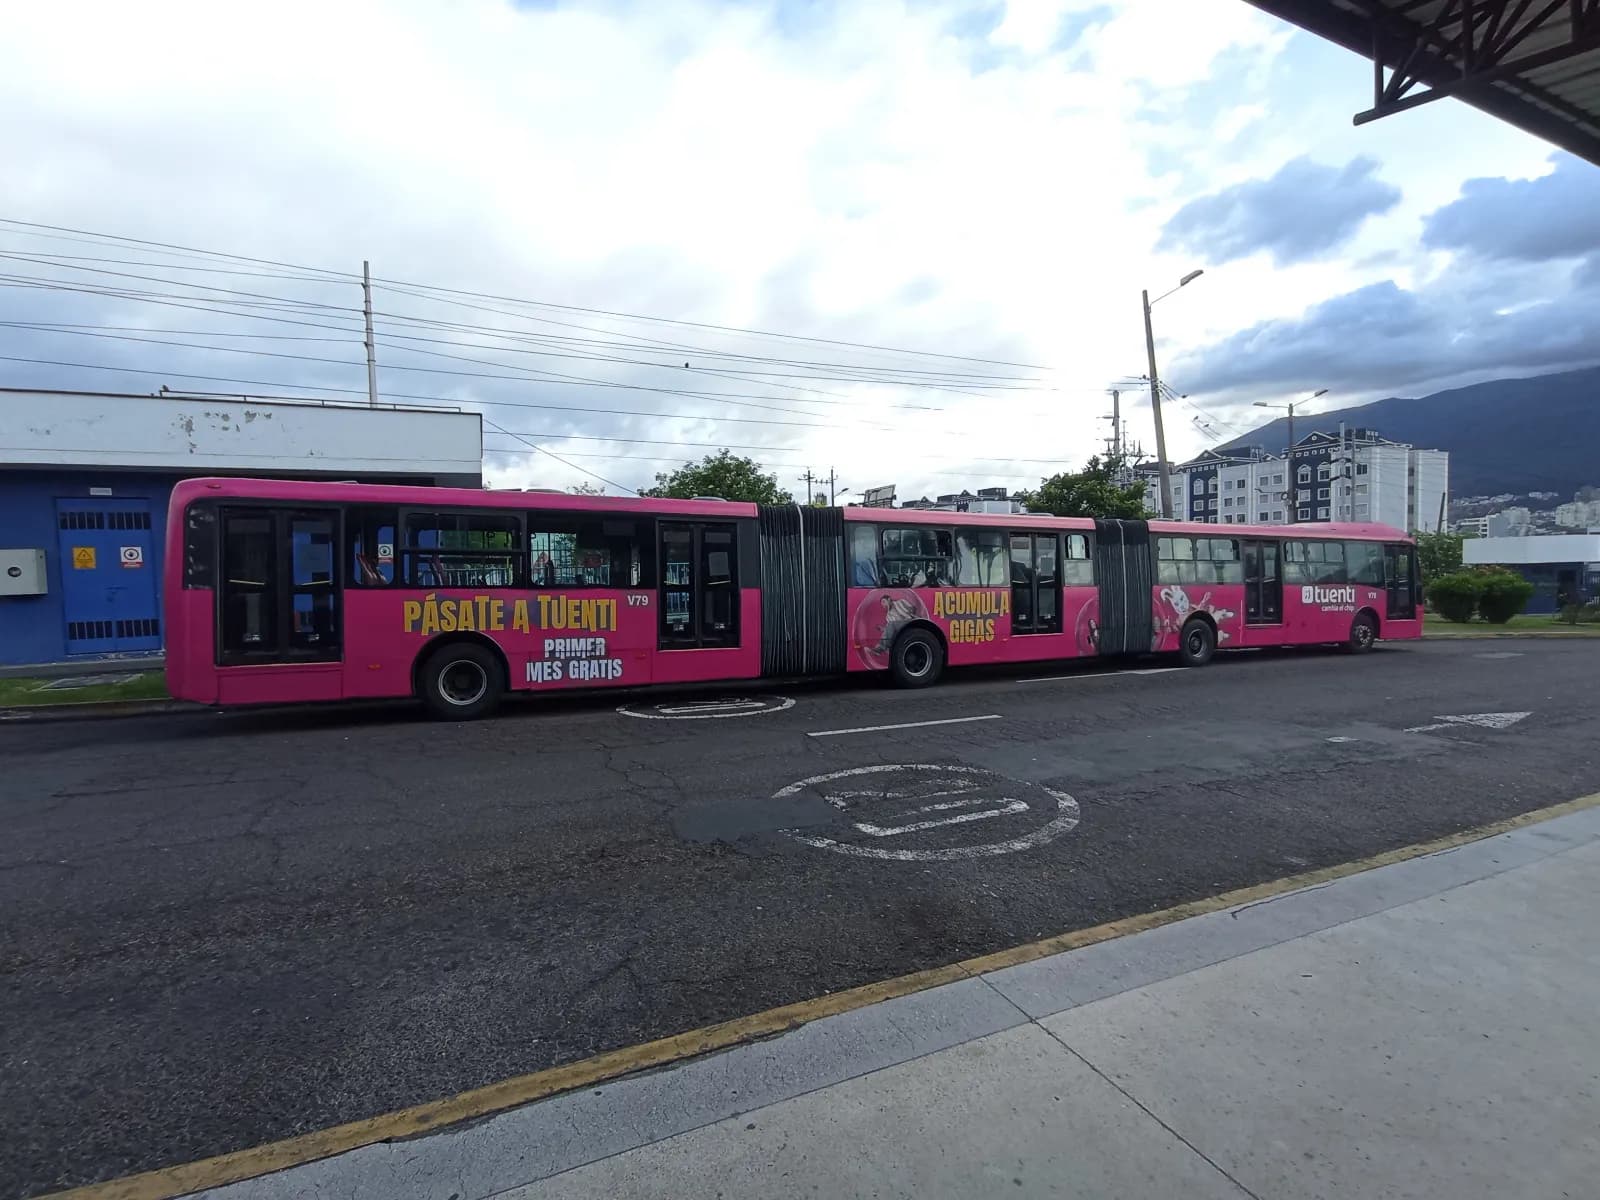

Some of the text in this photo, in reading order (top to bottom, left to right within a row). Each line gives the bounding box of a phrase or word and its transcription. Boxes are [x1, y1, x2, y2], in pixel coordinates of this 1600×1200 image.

[627, 595, 649, 606] V79
[933, 591, 1010, 619] ACUMULA
[1315, 585, 1355, 603] tuenti
[403, 593, 617, 635] PÁSATE A TUENTI
[950, 619, 994, 645] GIGAS
[544, 638, 606, 659] PRIMER
[526, 659, 622, 683] MES GRATIS
